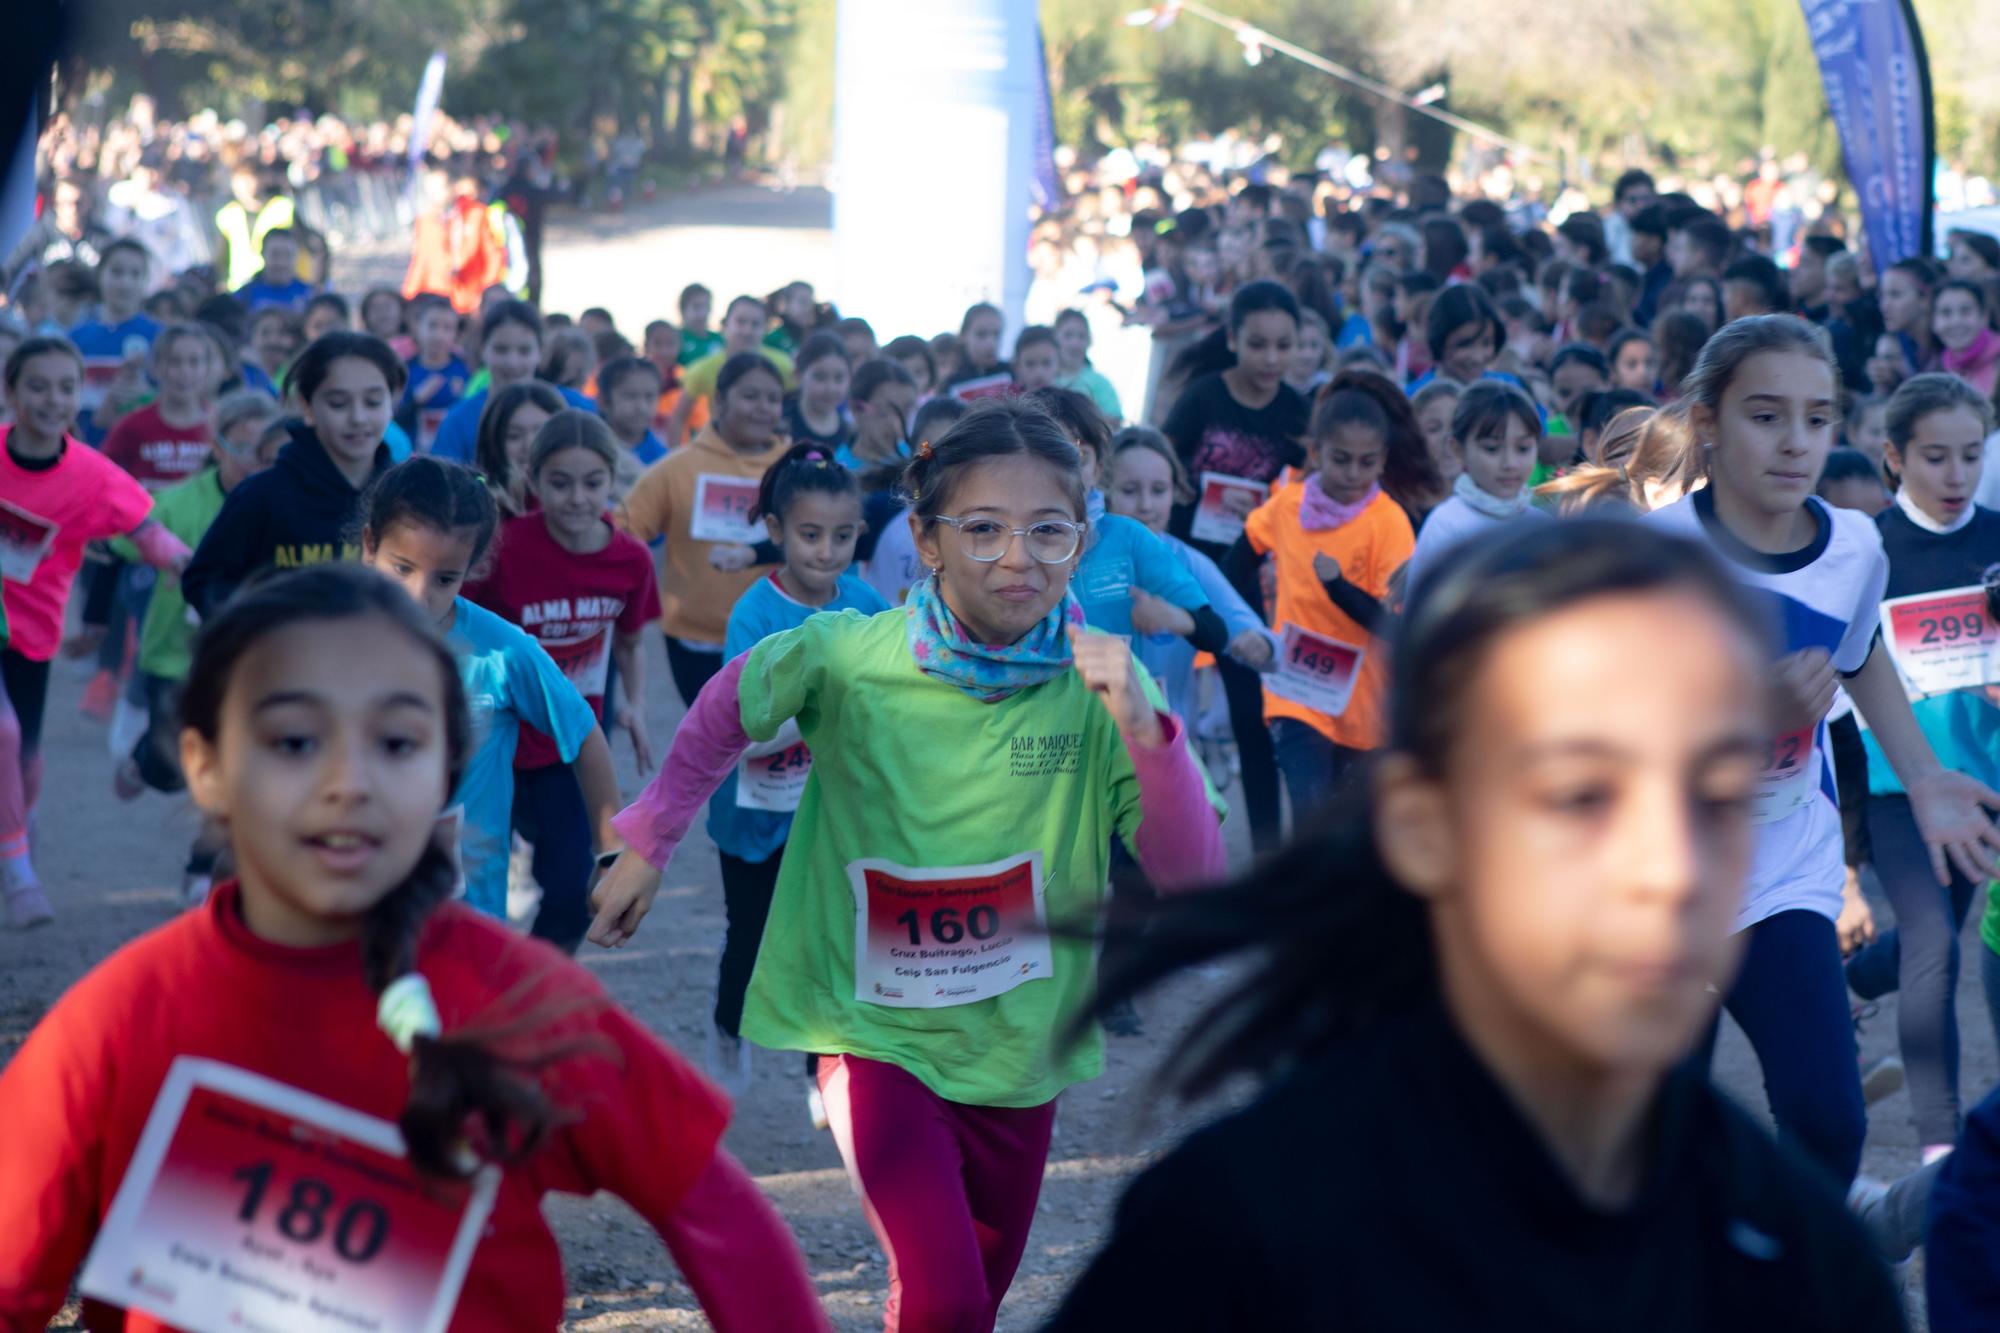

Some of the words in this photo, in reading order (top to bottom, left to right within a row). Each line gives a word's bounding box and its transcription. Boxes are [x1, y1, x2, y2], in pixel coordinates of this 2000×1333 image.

[275, 543, 333, 568] ALMA
[522, 599, 571, 625] ALMA
[1919, 612, 1983, 644] 299
[1292, 645, 1335, 675] 149
[1011, 736, 1034, 751] BAR
[768, 748, 812, 772] 24
[897, 903, 1000, 946] 160
[890, 948, 916, 959] Cruz
[920, 947, 977, 959] Buitrago,
[894, 967, 921, 978] Ceip
[925, 966, 949, 977] San
[952, 955, 1012, 975] Fulgencio
[232, 1160, 391, 1266] 180
